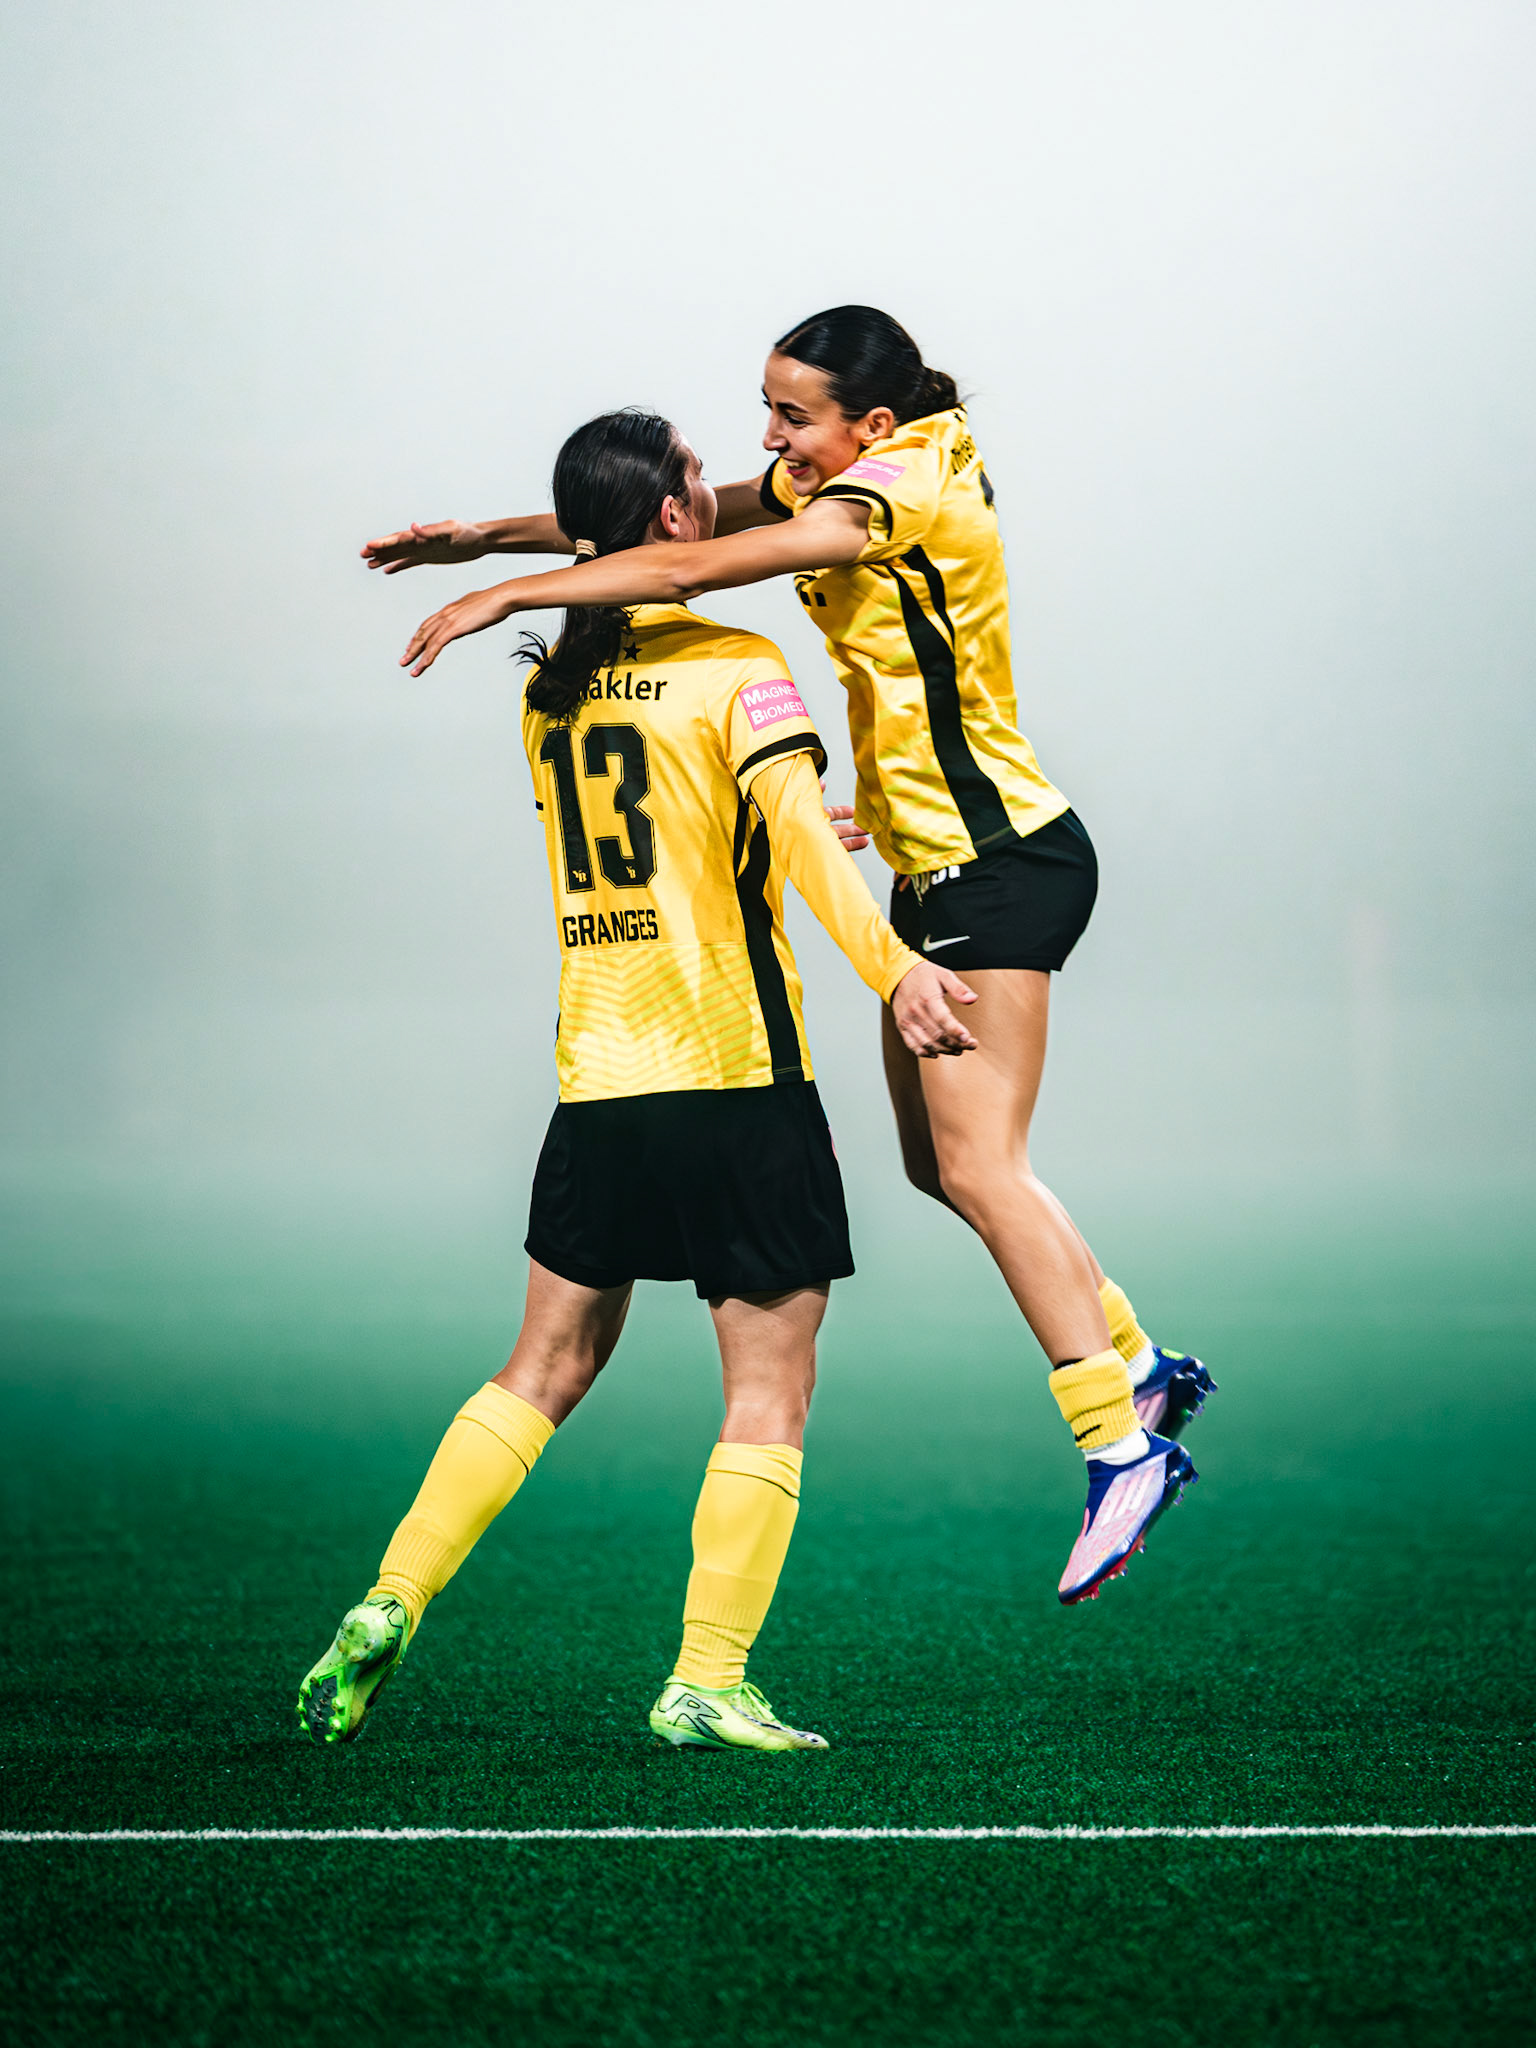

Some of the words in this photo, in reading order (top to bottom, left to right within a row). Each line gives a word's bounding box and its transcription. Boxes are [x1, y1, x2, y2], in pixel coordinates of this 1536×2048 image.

[579, 671, 668, 700] akler
[539, 722, 658, 894] 13
[562, 909, 659, 947] GRANGES
